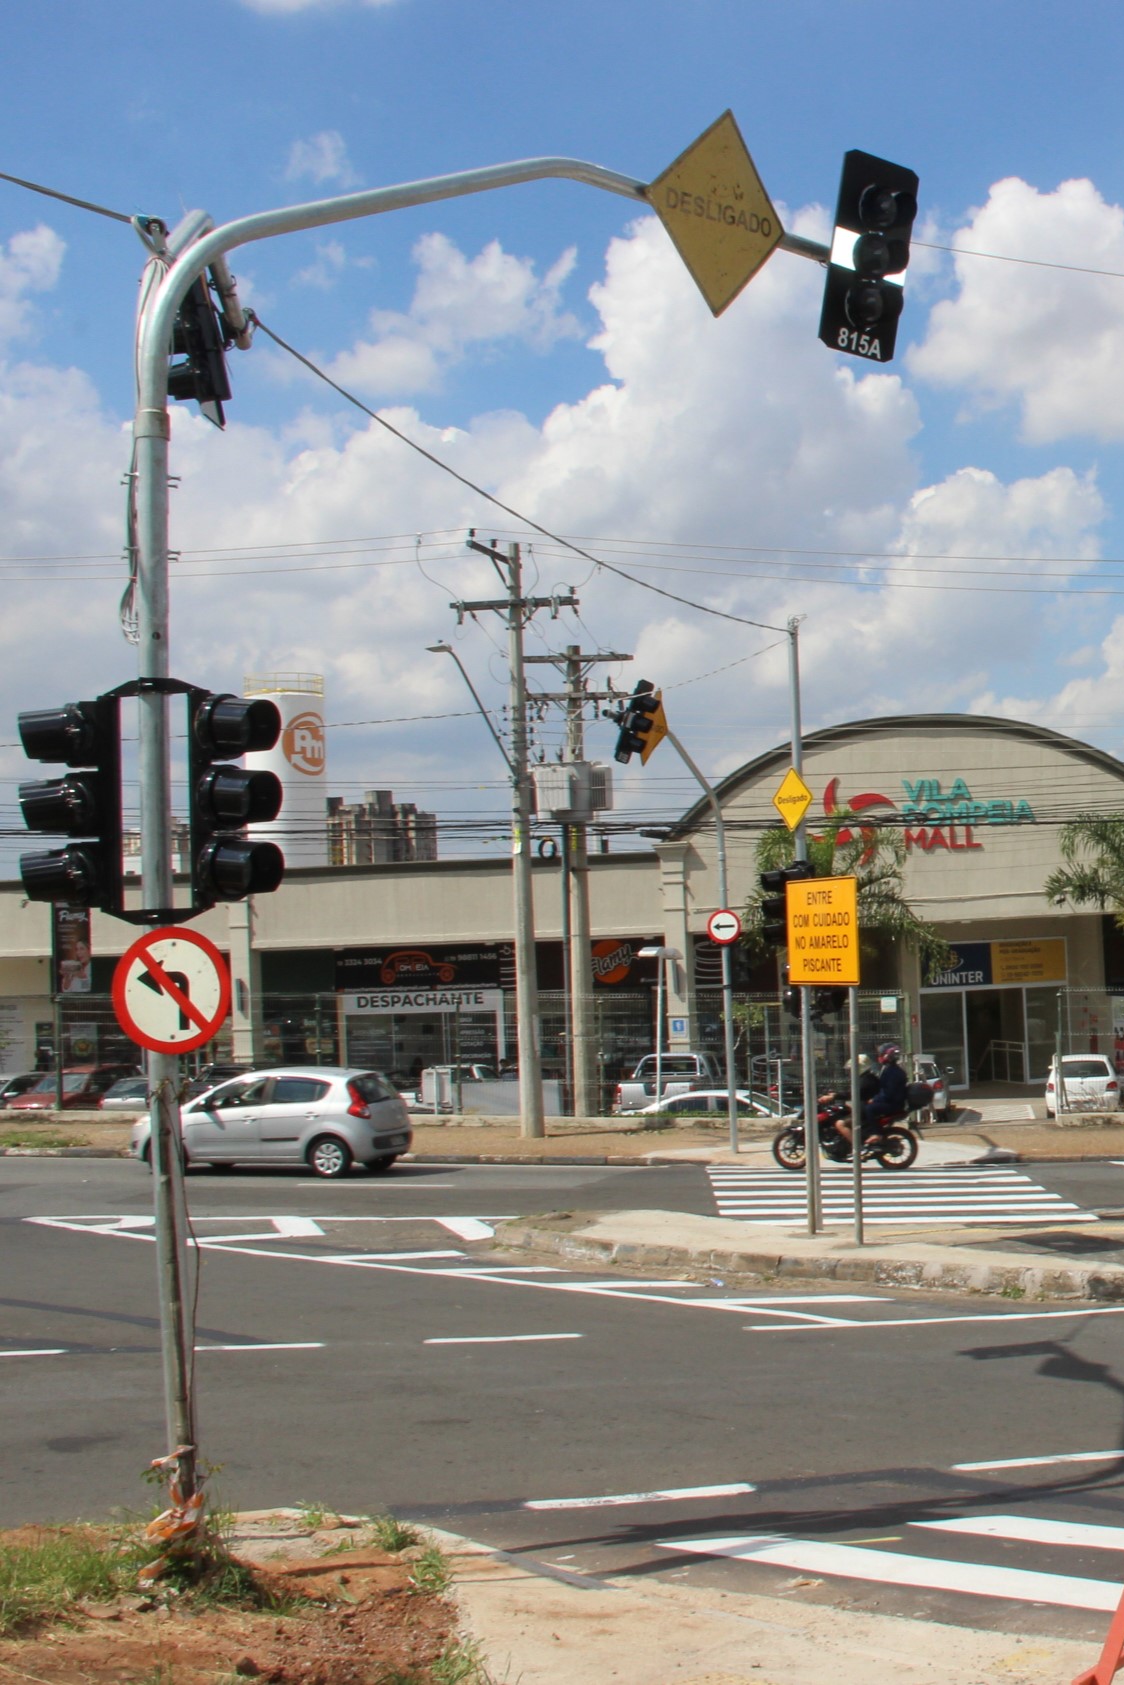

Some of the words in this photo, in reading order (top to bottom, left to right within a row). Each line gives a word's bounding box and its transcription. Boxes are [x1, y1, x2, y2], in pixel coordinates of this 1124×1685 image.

[666, 186, 773, 238] DESLIGADO
[837, 328, 882, 360] 815A
[901, 777, 973, 801] VILA
[777, 794, 808, 804] Desligado
[904, 826, 983, 850] MALL
[807, 890, 833, 906] ENTRE
[793, 914, 810, 928] COM
[813, 912, 850, 927] CUIDADO
[795, 936, 806, 949] NO
[809, 935, 849, 949] AMARELO
[803, 957, 842, 973] PISCANTE
[931, 971, 984, 986] UNINTER
[356, 992, 485, 1009] DESPACHANTE
